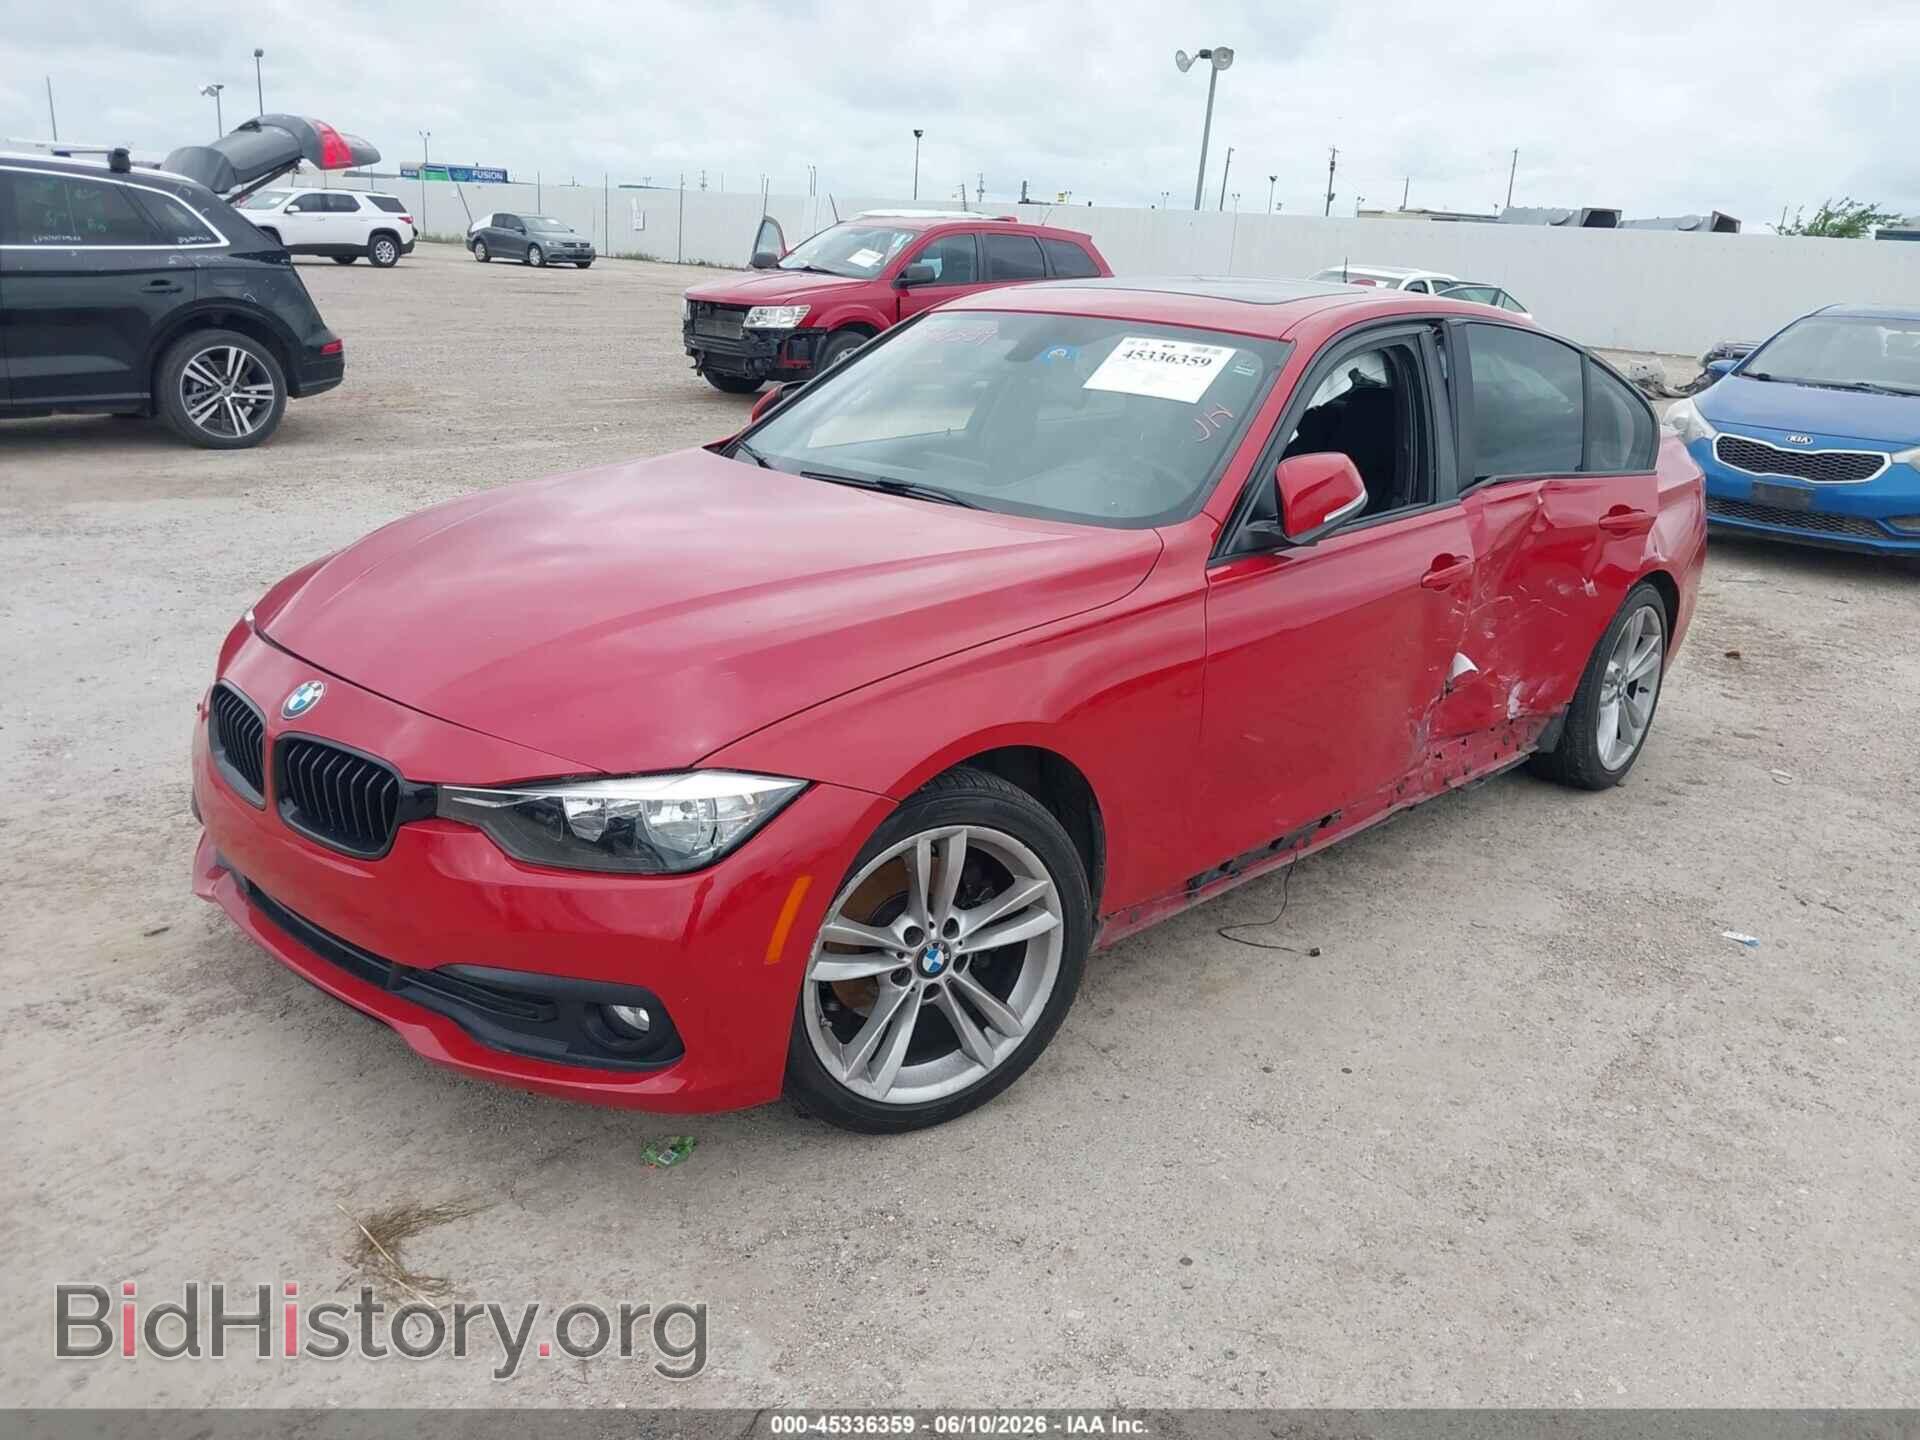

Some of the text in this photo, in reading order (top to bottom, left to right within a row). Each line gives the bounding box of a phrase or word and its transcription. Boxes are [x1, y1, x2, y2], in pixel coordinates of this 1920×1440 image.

[472, 169, 504, 180] FUSION
[1122, 349, 1213, 367] 45336359
[1788, 435, 1809, 444] KIA
